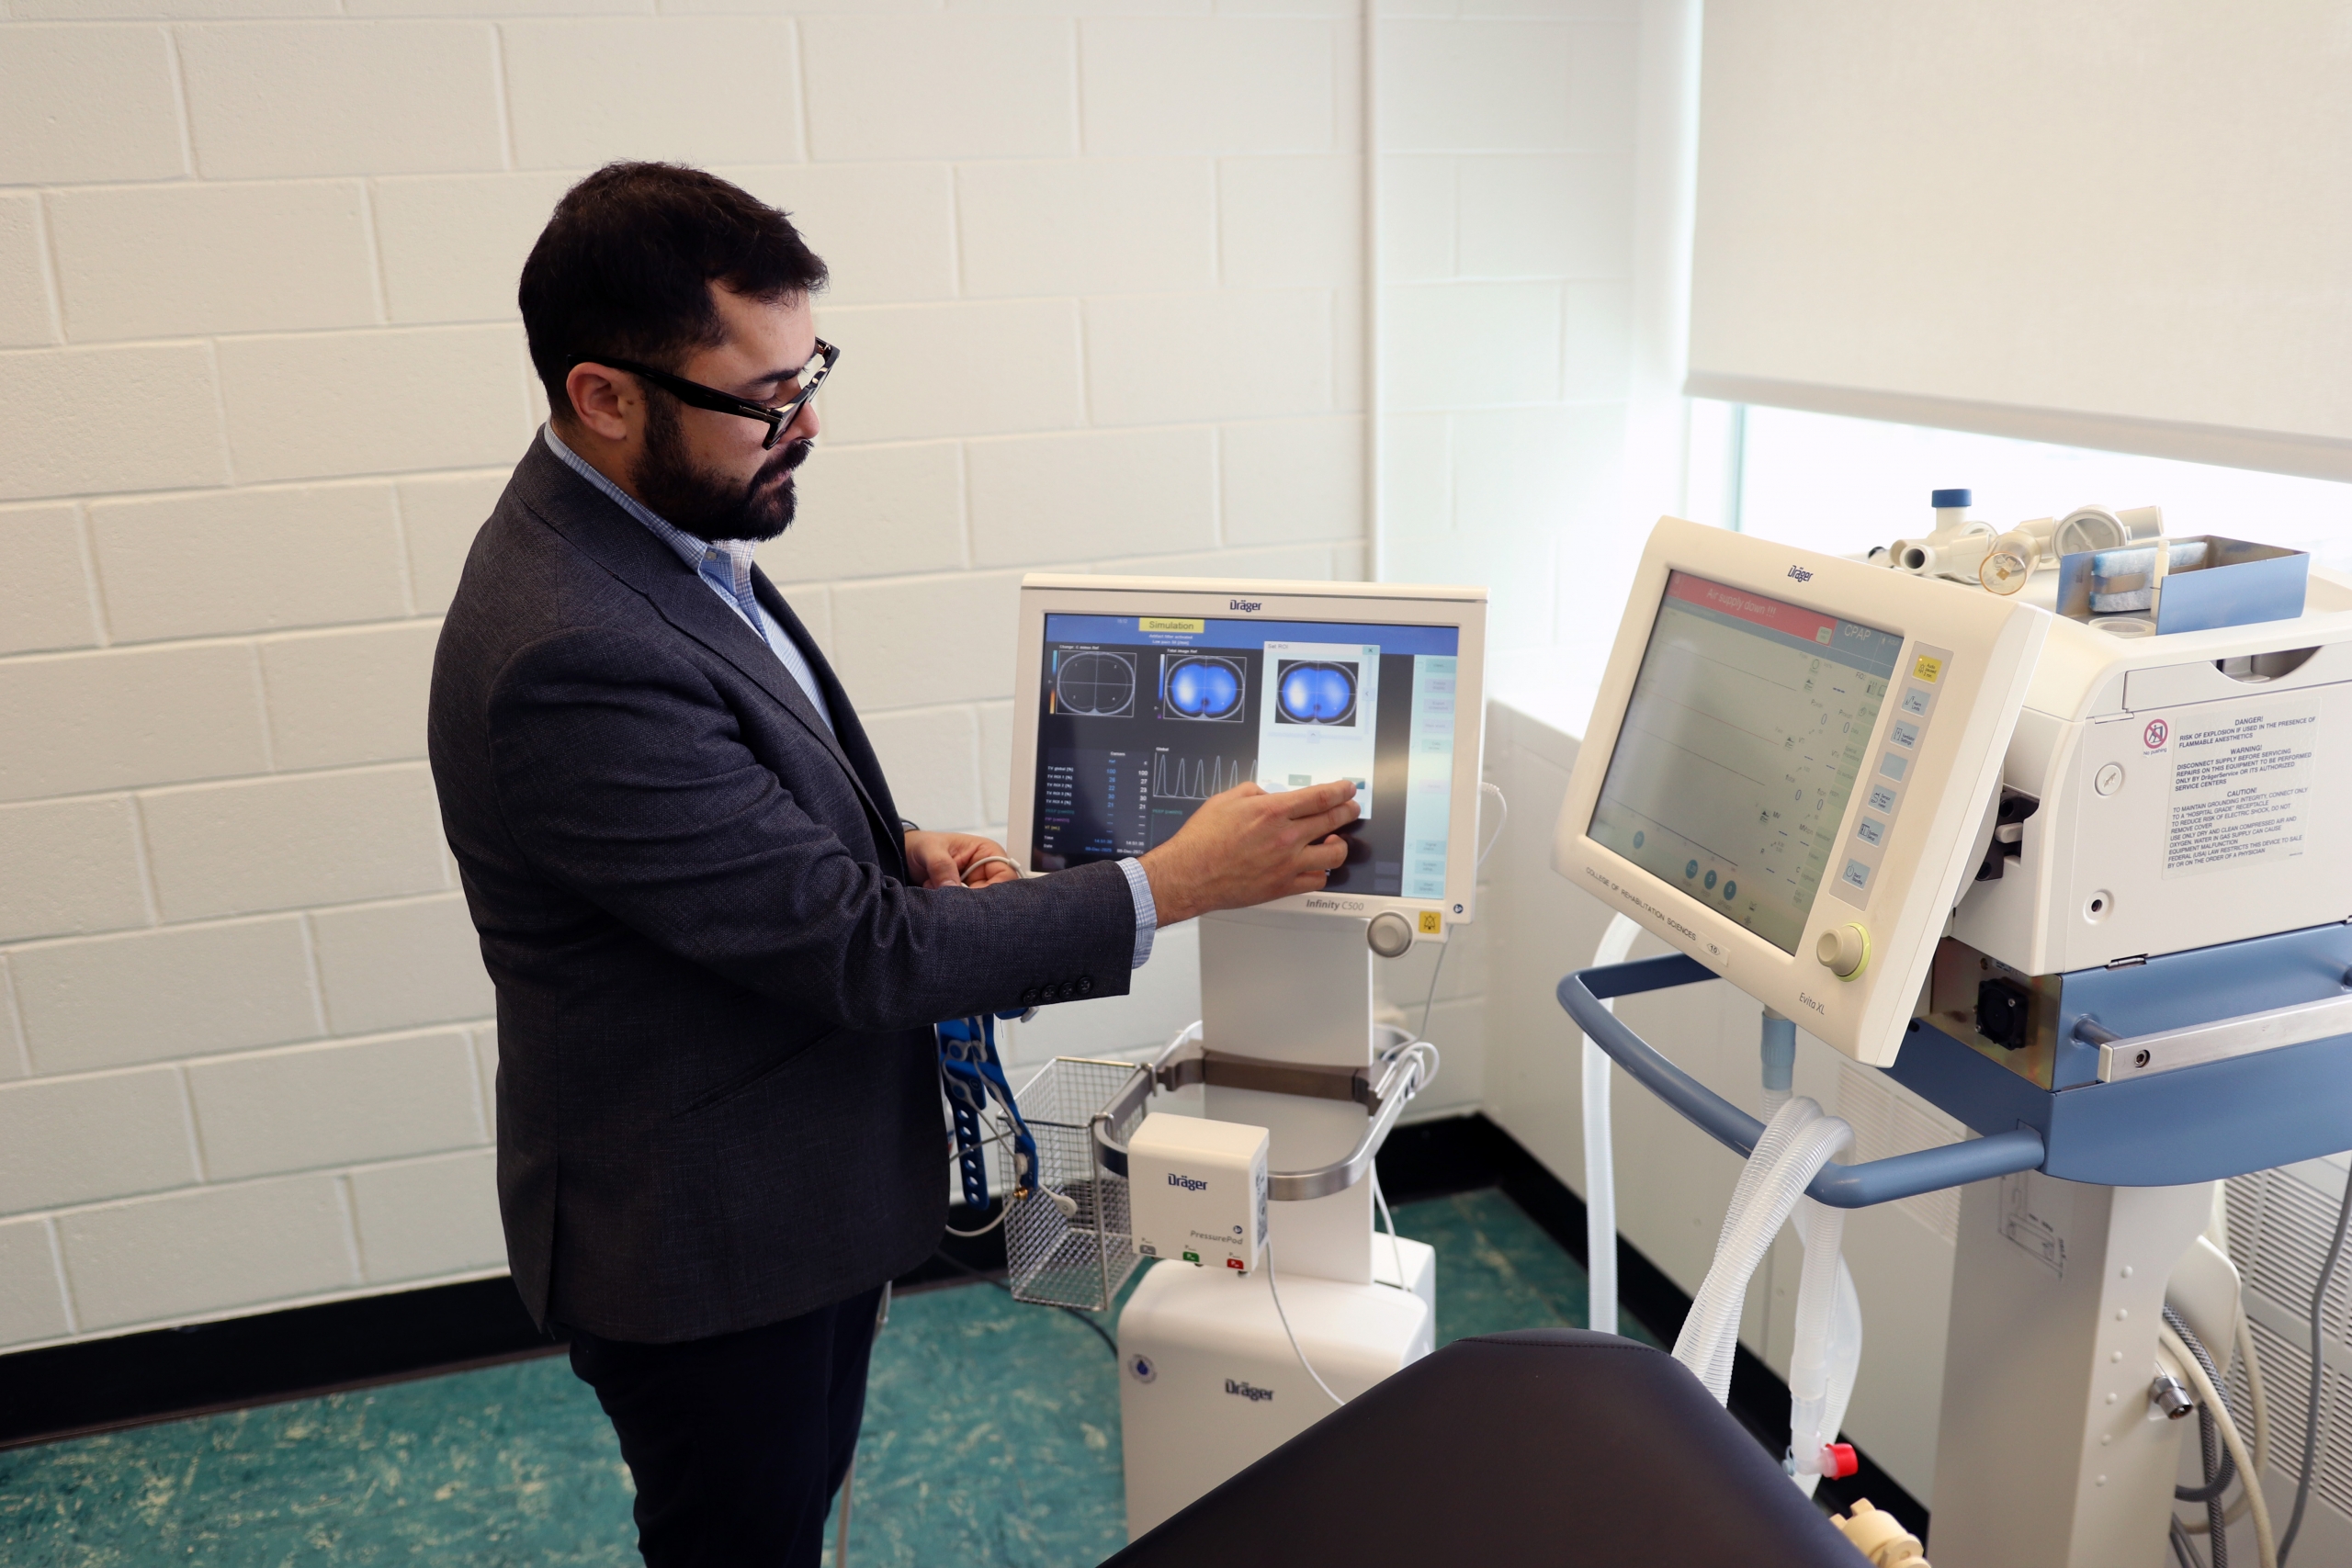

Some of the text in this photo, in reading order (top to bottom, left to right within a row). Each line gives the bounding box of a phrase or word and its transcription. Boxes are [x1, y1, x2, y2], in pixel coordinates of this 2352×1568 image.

[1788, 565, 1813, 582] Dräger
[1230, 600, 1262, 612] Dräger
[1707, 588, 1718, 599] Air
[1719, 592, 1744, 611] supply
[1745, 600, 1766, 615] down
[1149, 621, 1193, 630] Simulation
[1845, 625, 1871, 641] CPAP
[2179, 733, 2193, 741] RISK
[2203, 728, 2235, 738] EXPLOSION
[2242, 724, 2257, 732] USED
[2278, 717, 2307, 728] PRESENCE
[2234, 716, 2264, 726] DANGER!
[2178, 732, 2253, 748] FLAMMABLE ANESTHETICS
[2151, 748, 2167, 756] pushing
[2230, 745, 2262, 755] WARNING!
[2177, 748, 2291, 771] DISCONNECT SUPPLY BEFORE SERVICING
[2177, 768, 2200, 777] REPAIRS
[2211, 764, 2224, 773] THIS
[2225, 760, 2258, 771] EQUIPMENT
[2277, 752, 2312, 763] PERFORMED
[2176, 776, 2191, 784] ONLY
[2258, 761, 2295, 773] AUTHORIZED
[2175, 778, 2227, 792] SERVICE CENTERS
[2227, 787, 2257, 797] CAUTION!
[2181, 802, 2206, 812] MAINTAIN
[2207, 797, 2240, 807] GROUNDING
[2268, 789, 2293, 798] CONNECT
[2235, 800, 2269, 810] RECEPTACLE
[2179, 817, 2202, 826] REDUCE
[2224, 810, 2249, 819] ELECTRIC
[2171, 822, 2212, 834] REMOVE COVER
[2181, 831, 2196, 840] ONLY
[2221, 825, 2238, 833] CLEAN
[2239, 818, 2275, 830] COMPRESSED
[2193, 836, 2212, 844] WATER
[2232, 829, 2252, 839] SUPPLY
[2264, 825, 2282, 833] CAUSE
[2167, 852, 2191, 862] FEDERAL
[2220, 843, 2248, 853] RESTRICTS
[2262, 838, 2280, 847] DEVICE
[2168, 839, 2239, 855] EQUIPMENT MALFUNCTION
[2205, 854, 2224, 863] ORDER
[2237, 848, 2266, 857] PHYSICIAN
[1306, 899, 1364, 910] Infinity C500
[1586, 866, 1696, 941] COLLEGE OF REHABILITATION SCIENCES
[1710, 945, 1718, 953] 10
[1799, 992, 1825, 1015] Evita XL
[1168, 1173, 1208, 1190] Dräger
[1190, 1231, 1243, 1245] PressurePod
[1225, 1378, 1274, 1402] Dräger
